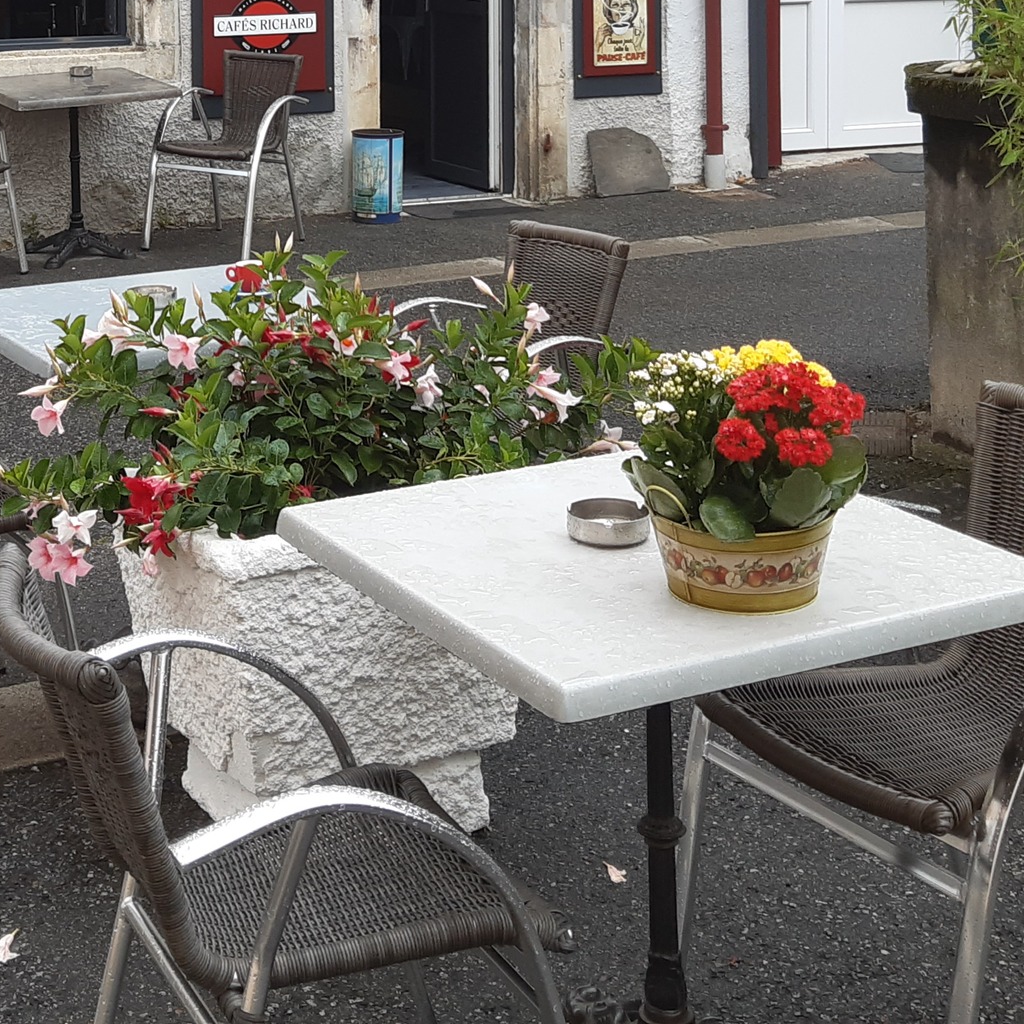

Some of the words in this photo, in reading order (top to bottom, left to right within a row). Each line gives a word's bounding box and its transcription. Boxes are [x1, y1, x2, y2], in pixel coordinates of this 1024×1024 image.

[217, 18, 257, 32] CAFÉS
[260, 17, 314, 31] RICHARD
[597, 51, 646, 62] PAUSE-CAFÉ
